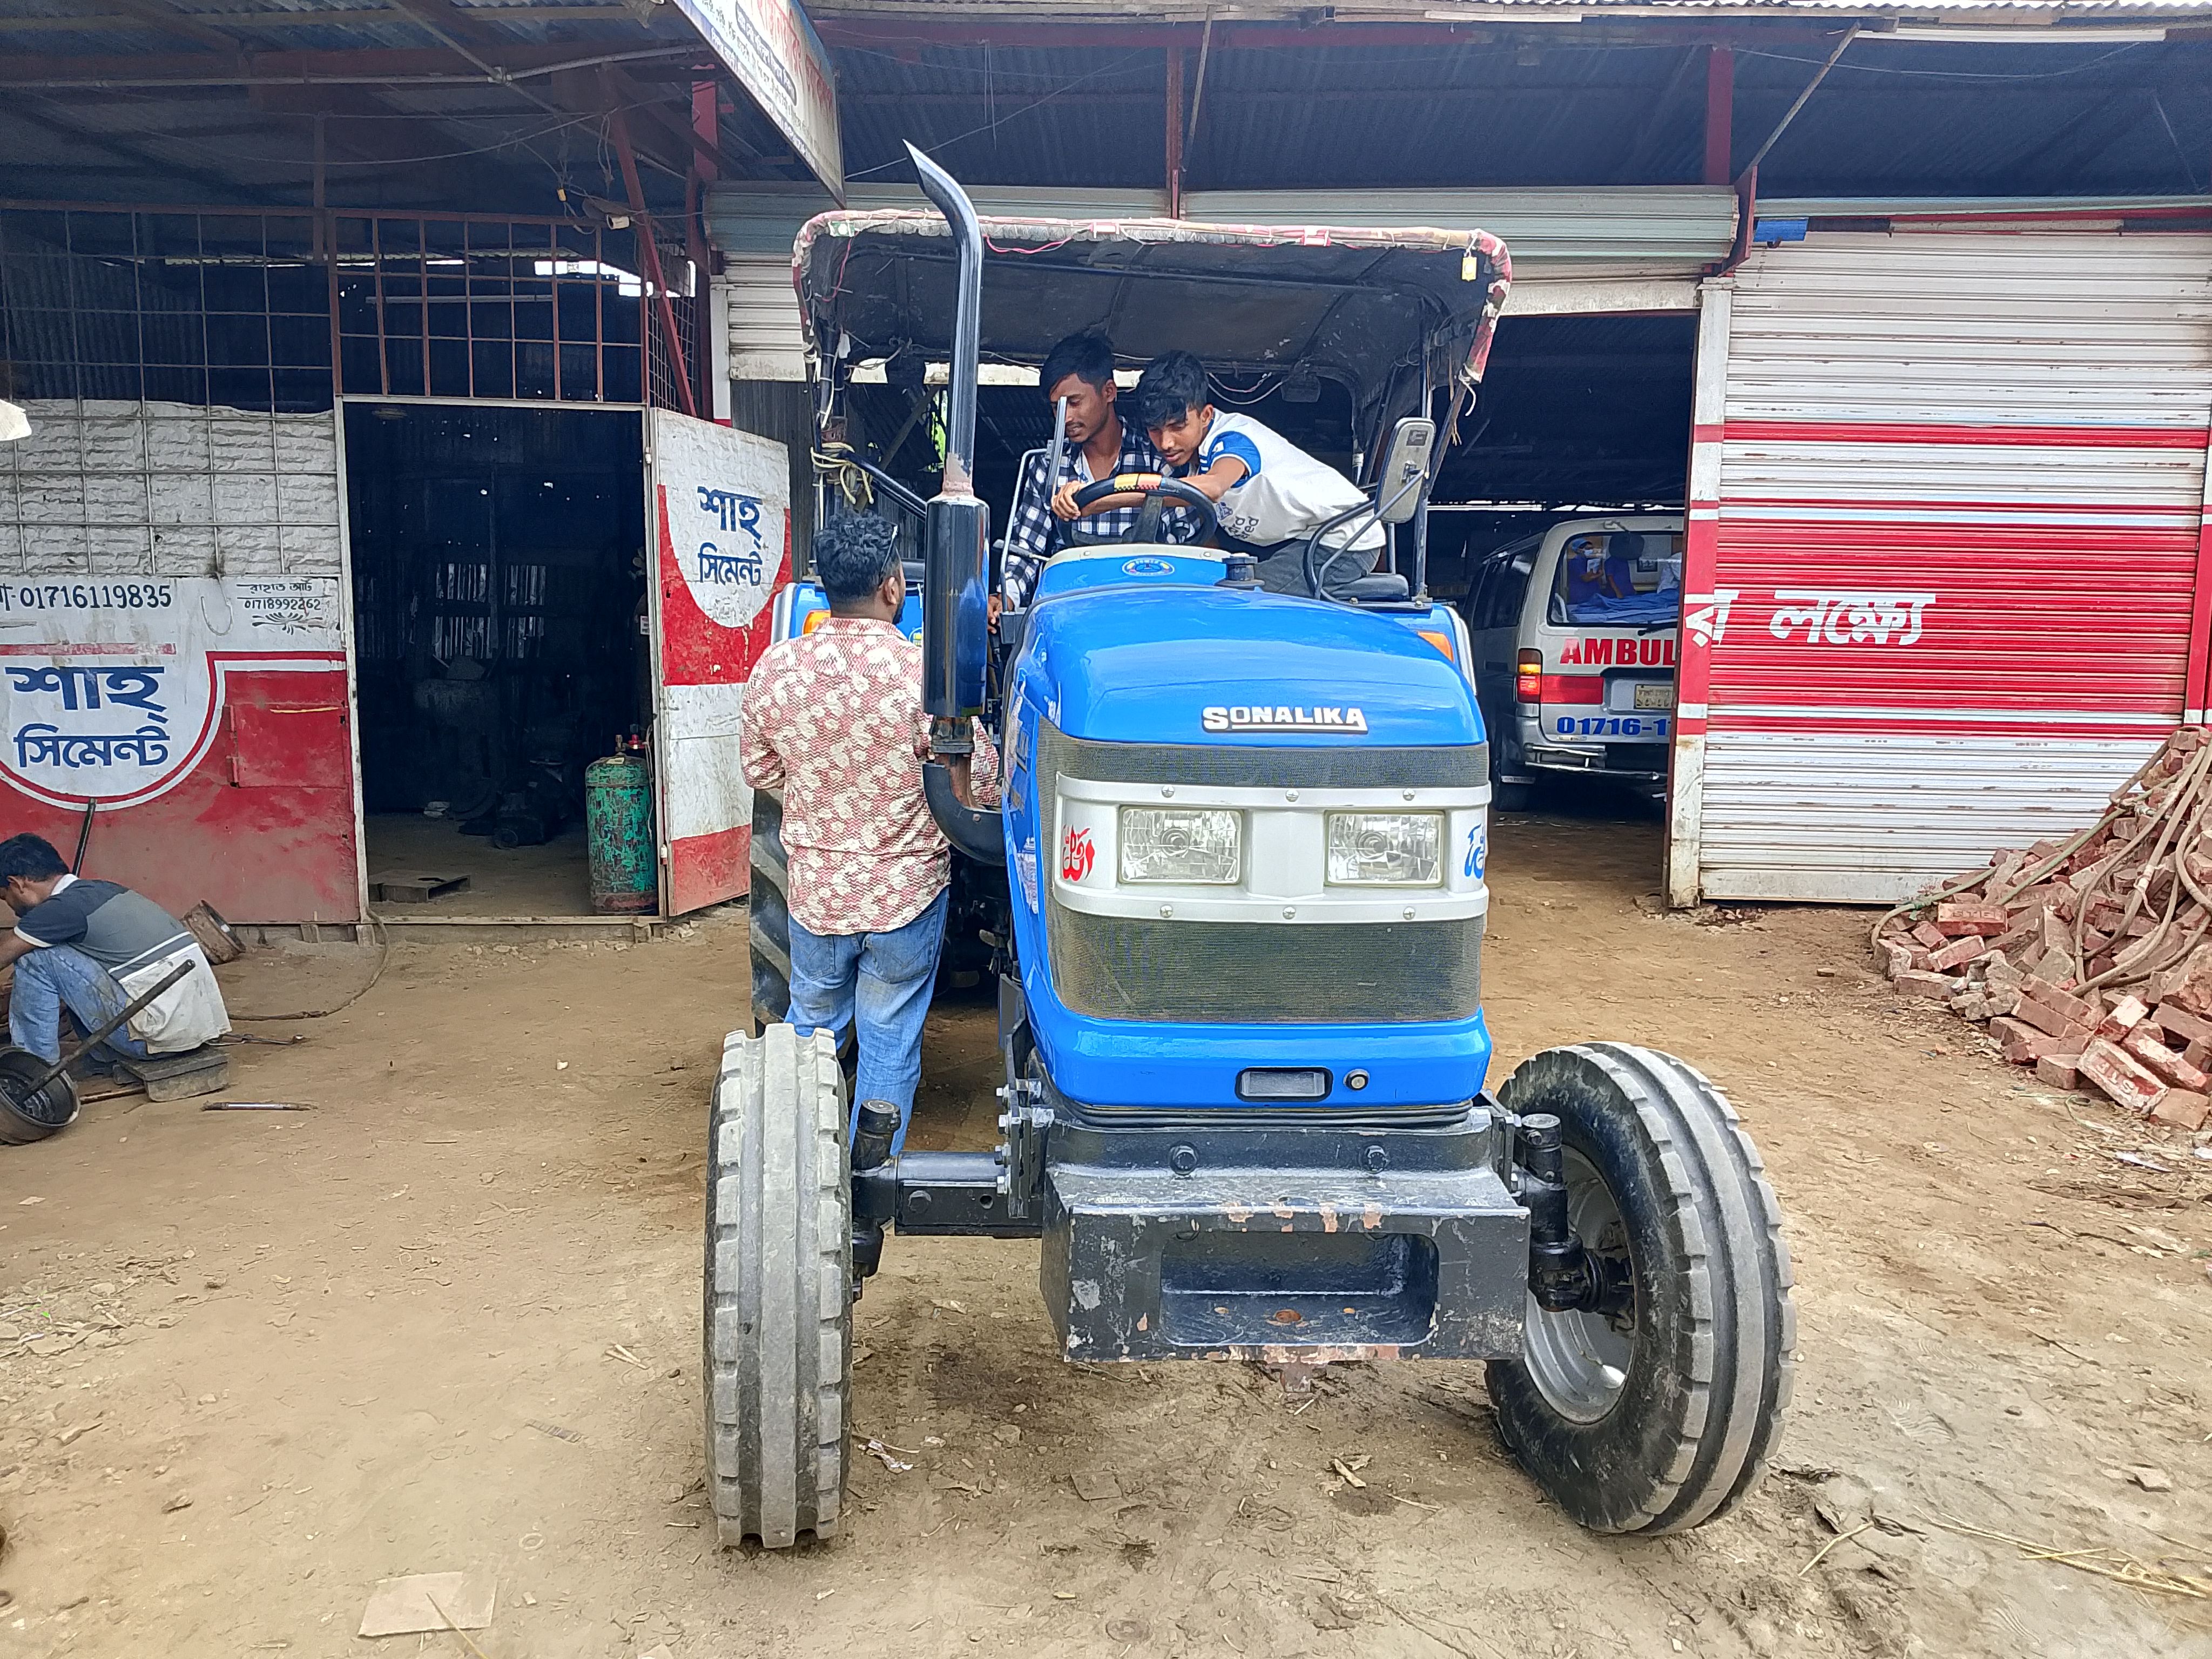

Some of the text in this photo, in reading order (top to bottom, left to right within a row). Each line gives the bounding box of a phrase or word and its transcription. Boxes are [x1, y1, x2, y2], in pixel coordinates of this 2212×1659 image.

[697, 542, 763, 586] সিমেন্ট
[1559, 638, 1676, 666] AMBUL
[1202, 706, 1369, 732] SONALIKA
[1556, 716, 1671, 736] 01716-1
[12, 723, 171, 768] সিমেন্ট
